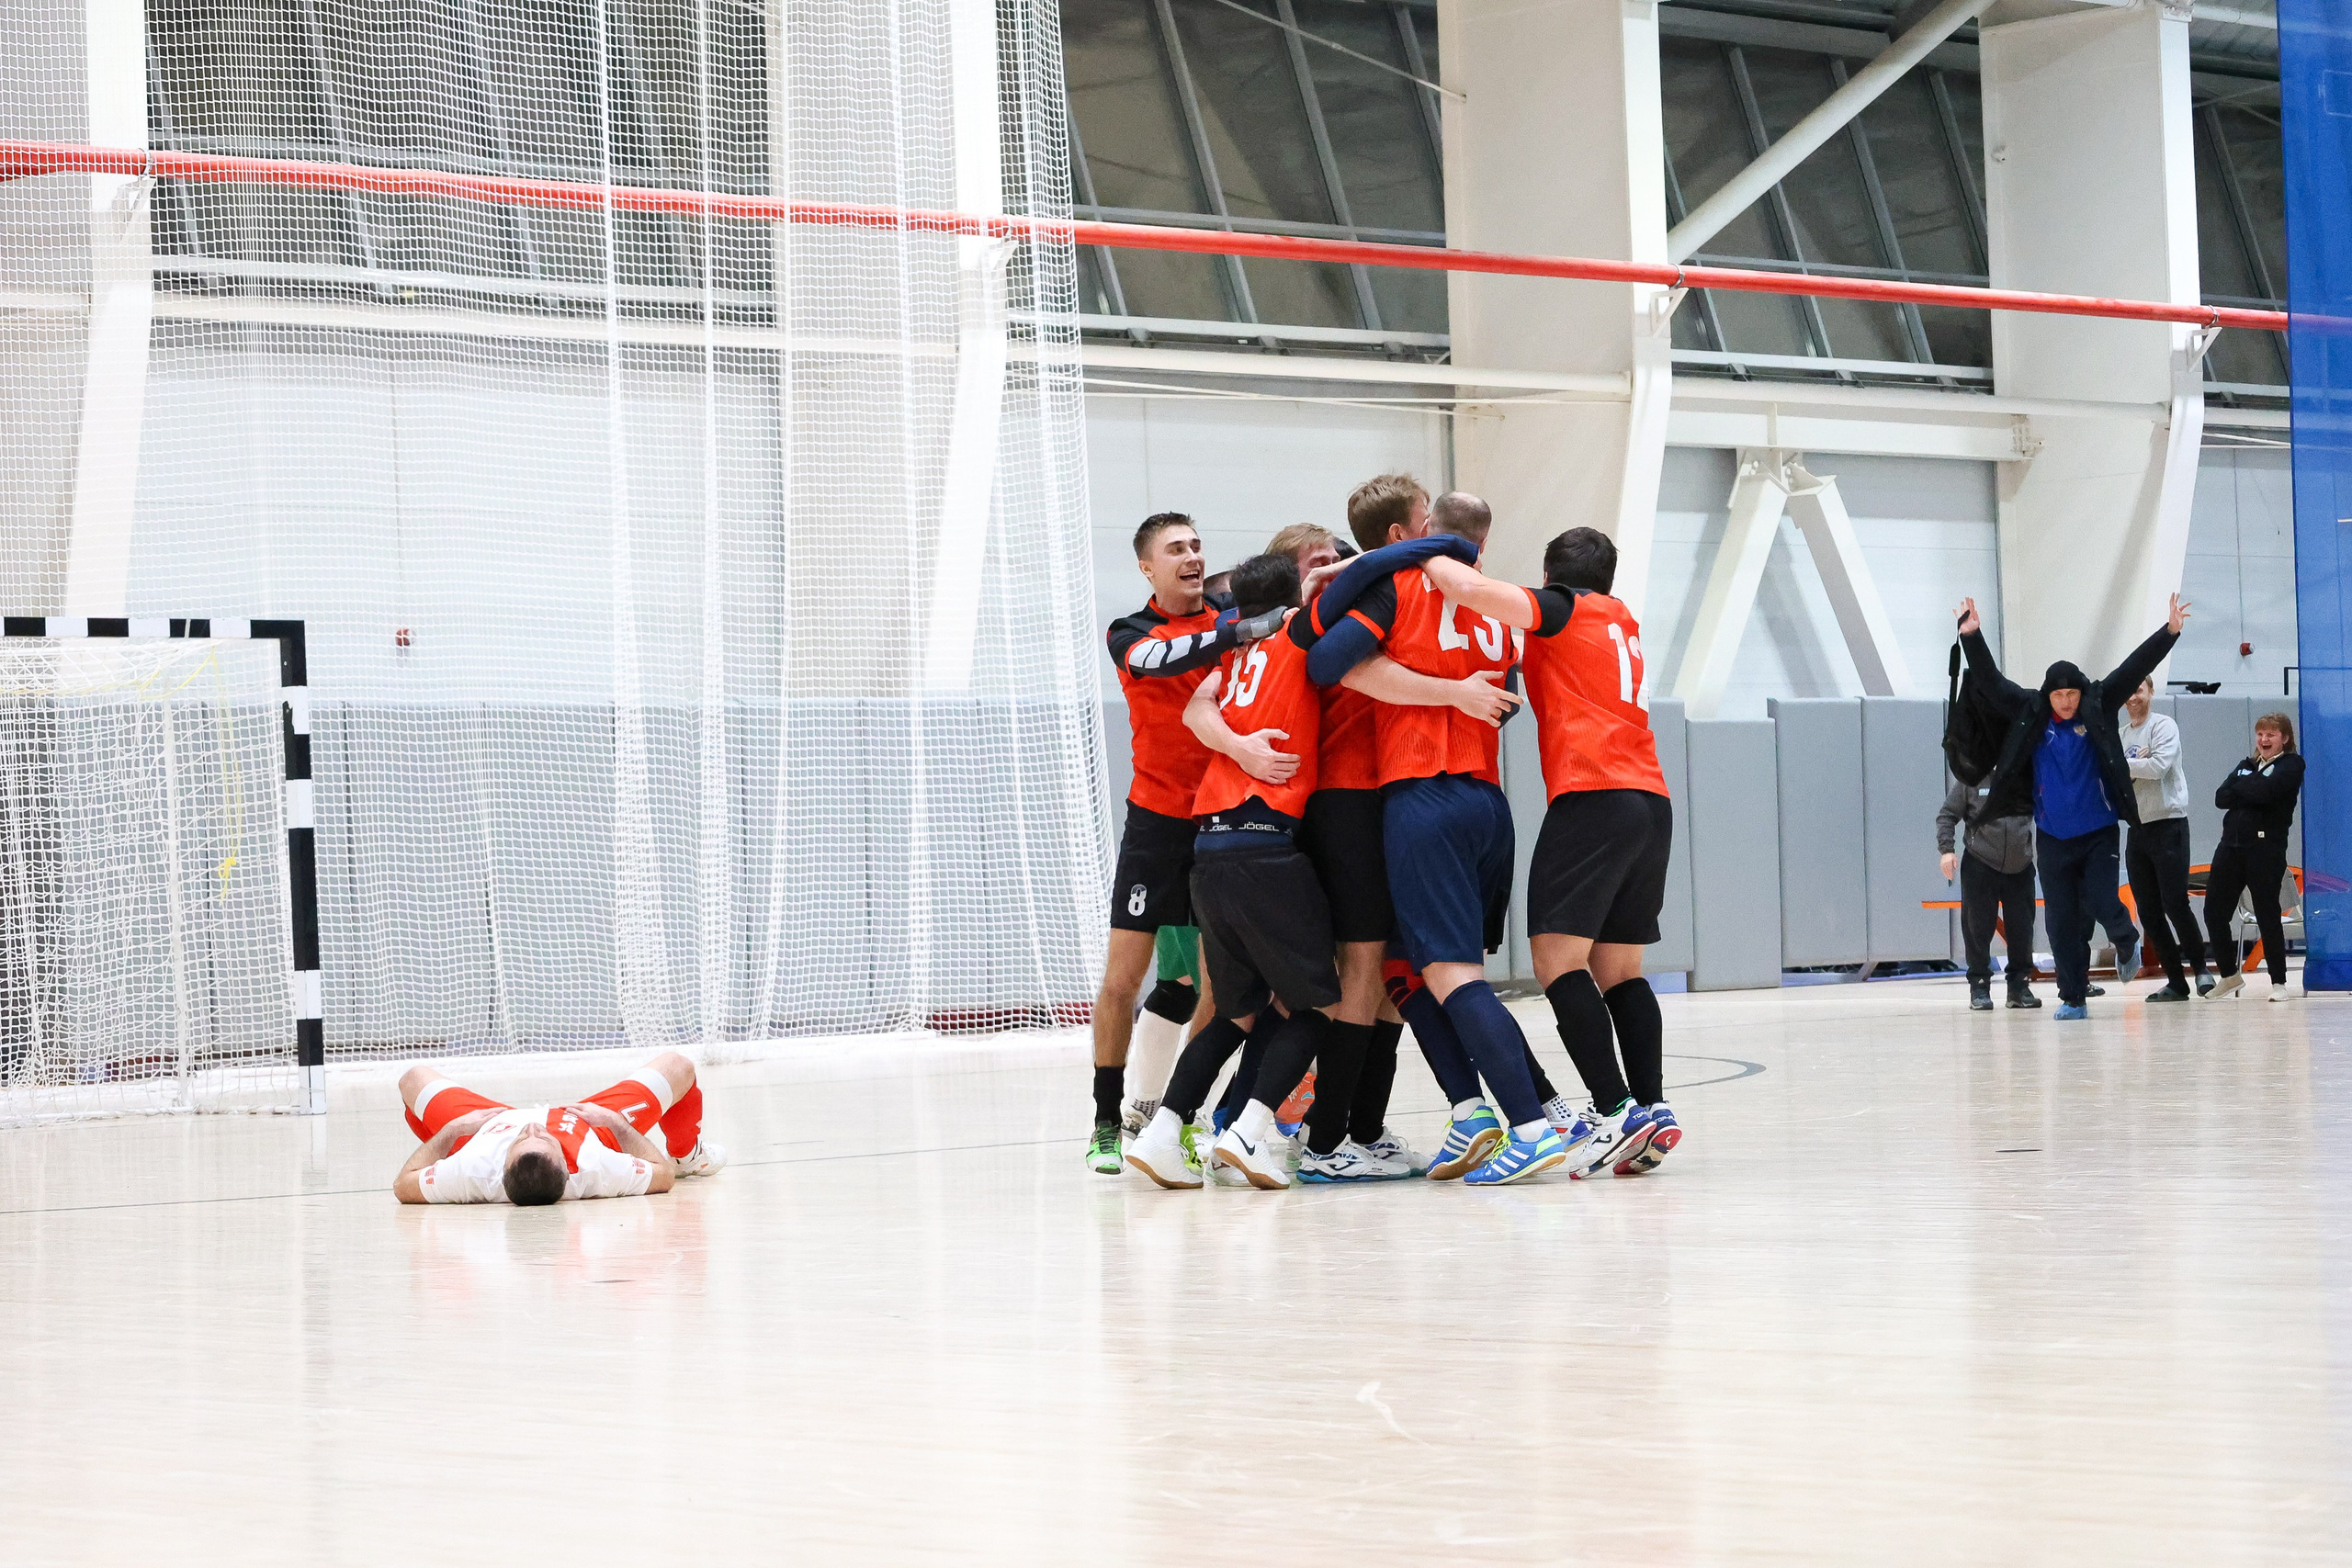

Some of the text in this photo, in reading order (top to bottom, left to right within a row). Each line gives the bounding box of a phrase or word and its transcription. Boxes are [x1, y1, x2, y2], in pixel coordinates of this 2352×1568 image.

[1209, 824, 1233, 832] JÖGEL
[1238, 821, 1280, 832] JÖGEL
[1128, 884, 1148, 917] 8
